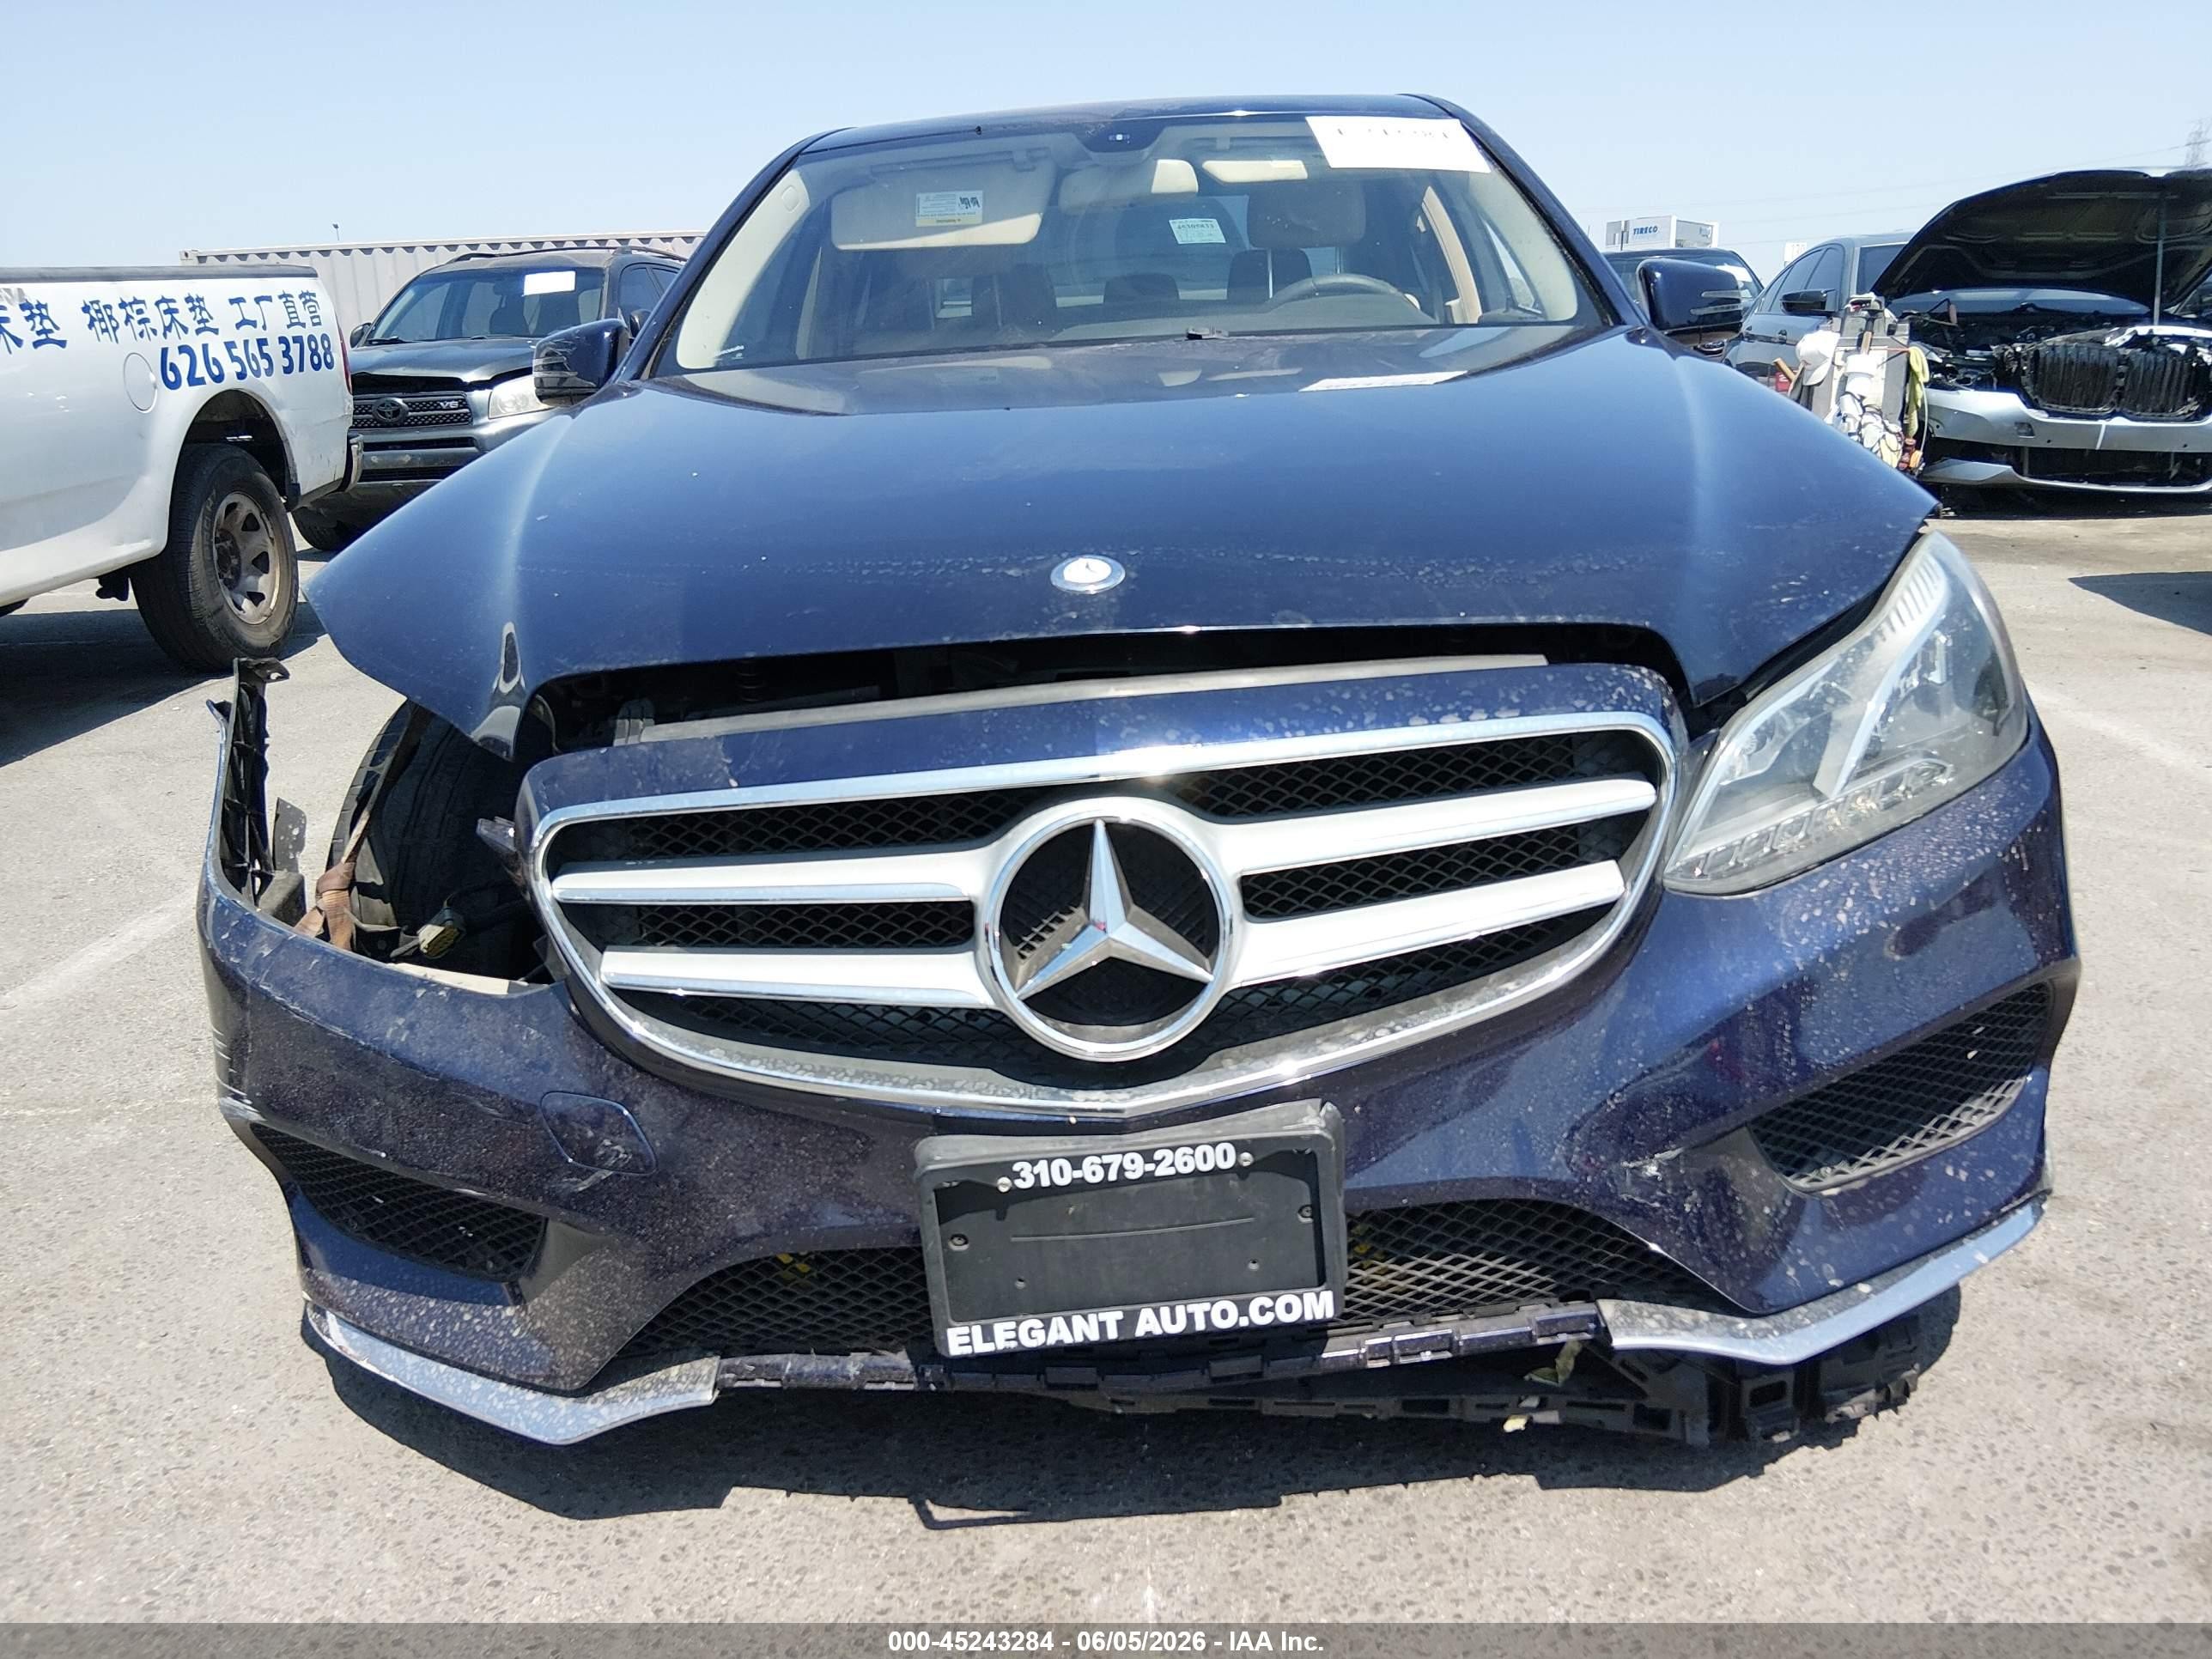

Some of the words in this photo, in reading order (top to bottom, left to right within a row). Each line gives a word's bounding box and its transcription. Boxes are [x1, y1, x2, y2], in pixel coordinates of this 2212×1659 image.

[1633, 225, 1658, 234] TIRECO
[82, 292, 219, 344] 椰棕床垫
[228, 289, 323, 331] 工厂直营
[160, 343, 226, 391] 626
[223, 337, 275, 381] 565
[277, 332, 335, 375] 3788
[439, 400, 459, 410] V6
[1012, 1142, 1237, 1189] 310-679-2600
[945, 1311, 1124, 1357] ELEGANT
[1134, 1290, 1335, 1338] AUTO.COM
